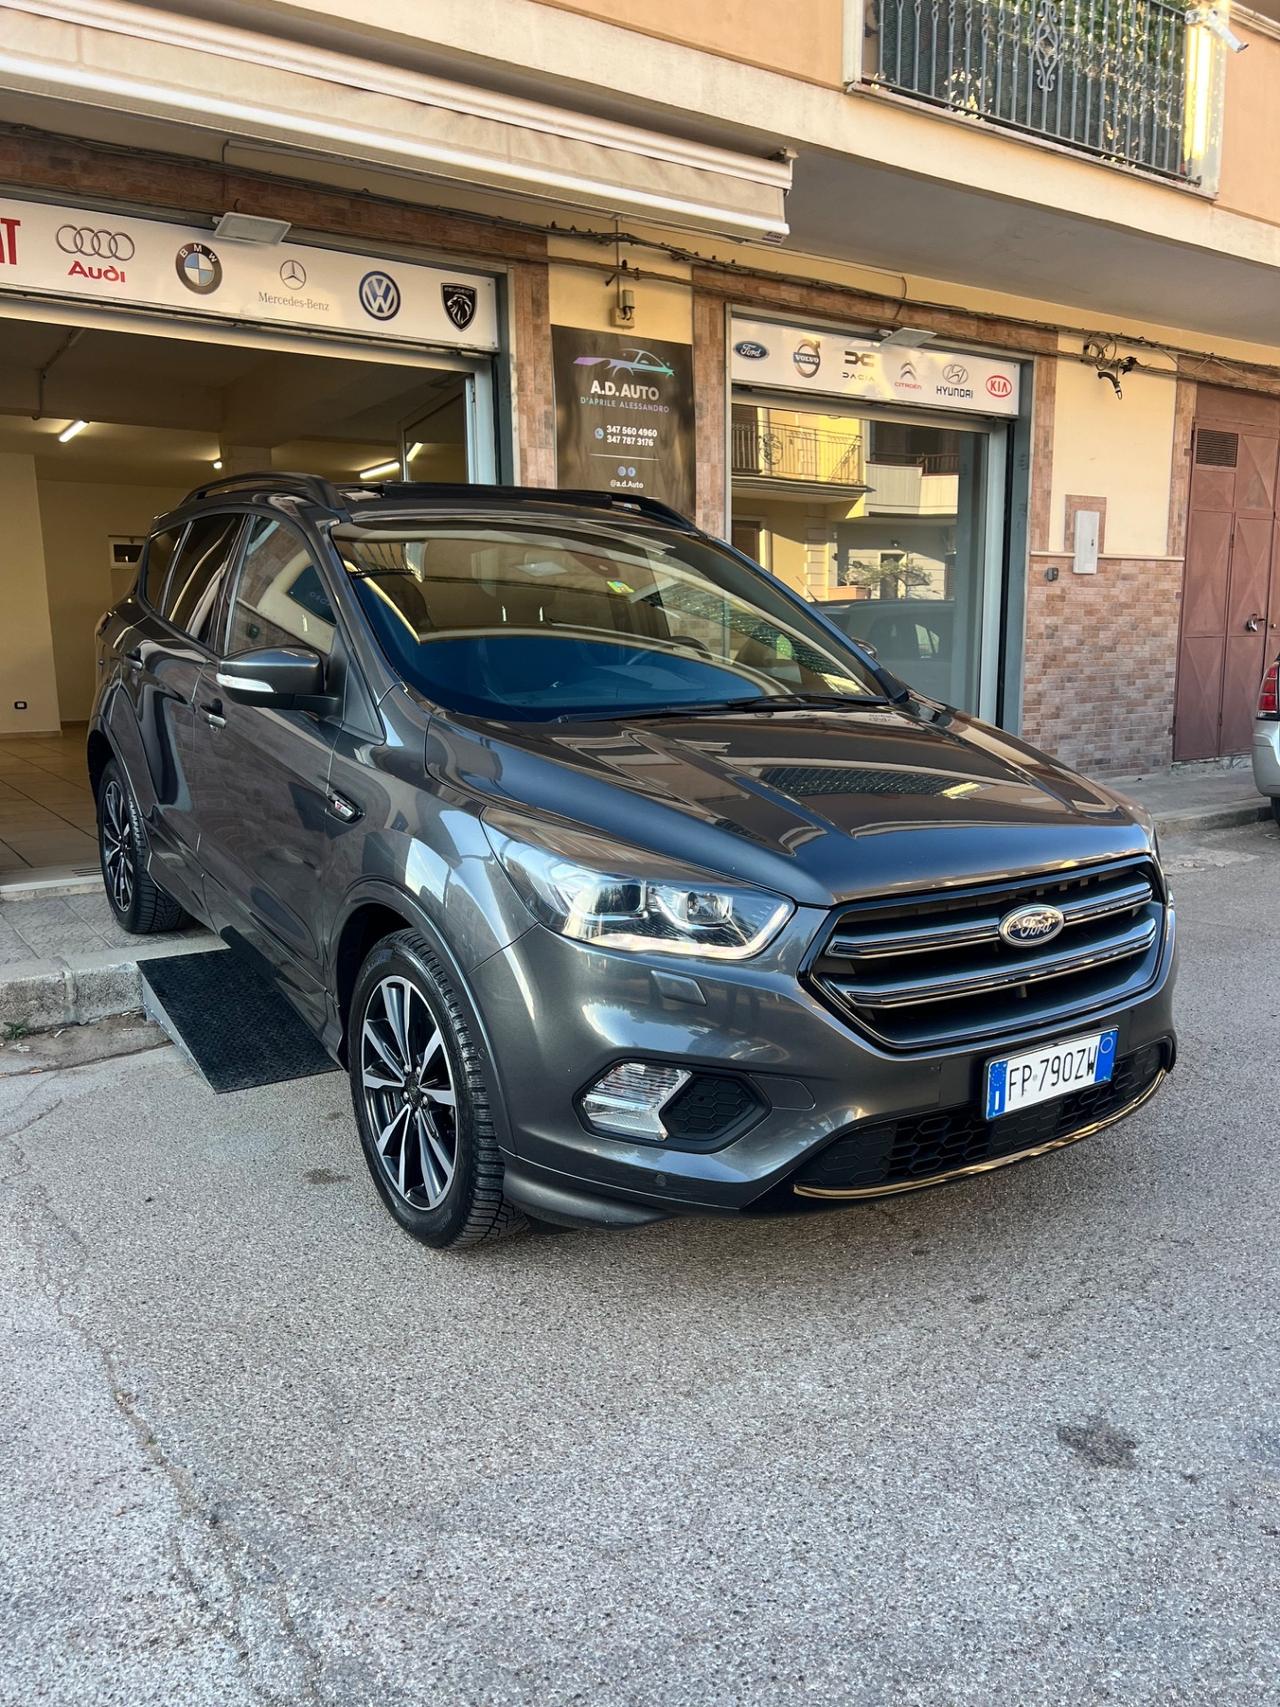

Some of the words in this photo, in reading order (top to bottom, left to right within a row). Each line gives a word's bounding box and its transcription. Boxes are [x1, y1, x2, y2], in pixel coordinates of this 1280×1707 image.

[0, 217, 21, 265] T
[178, 243, 218, 264] BMW
[67, 260, 126, 283] Audi
[258, 291, 330, 312] Mercedes-Benz
[740, 343, 762, 357] Ford
[795, 354, 819, 363] VOLVO
[936, 386, 974, 399] HYUNDAI
[990, 379, 1008, 393] KIA
[580, 396, 617, 408] D'APRILE
[619, 400, 670, 414] ALESSANDRO
[606, 424, 621, 434] 347
[638, 428, 658, 438] 4960
[606, 434, 621, 444] 347
[637, 438, 654, 447] 3176
[1020, 915, 1053, 938] Ford
[1008, 1065, 1032, 1101] FP
[1038, 1045, 1098, 1092] 790ZW
